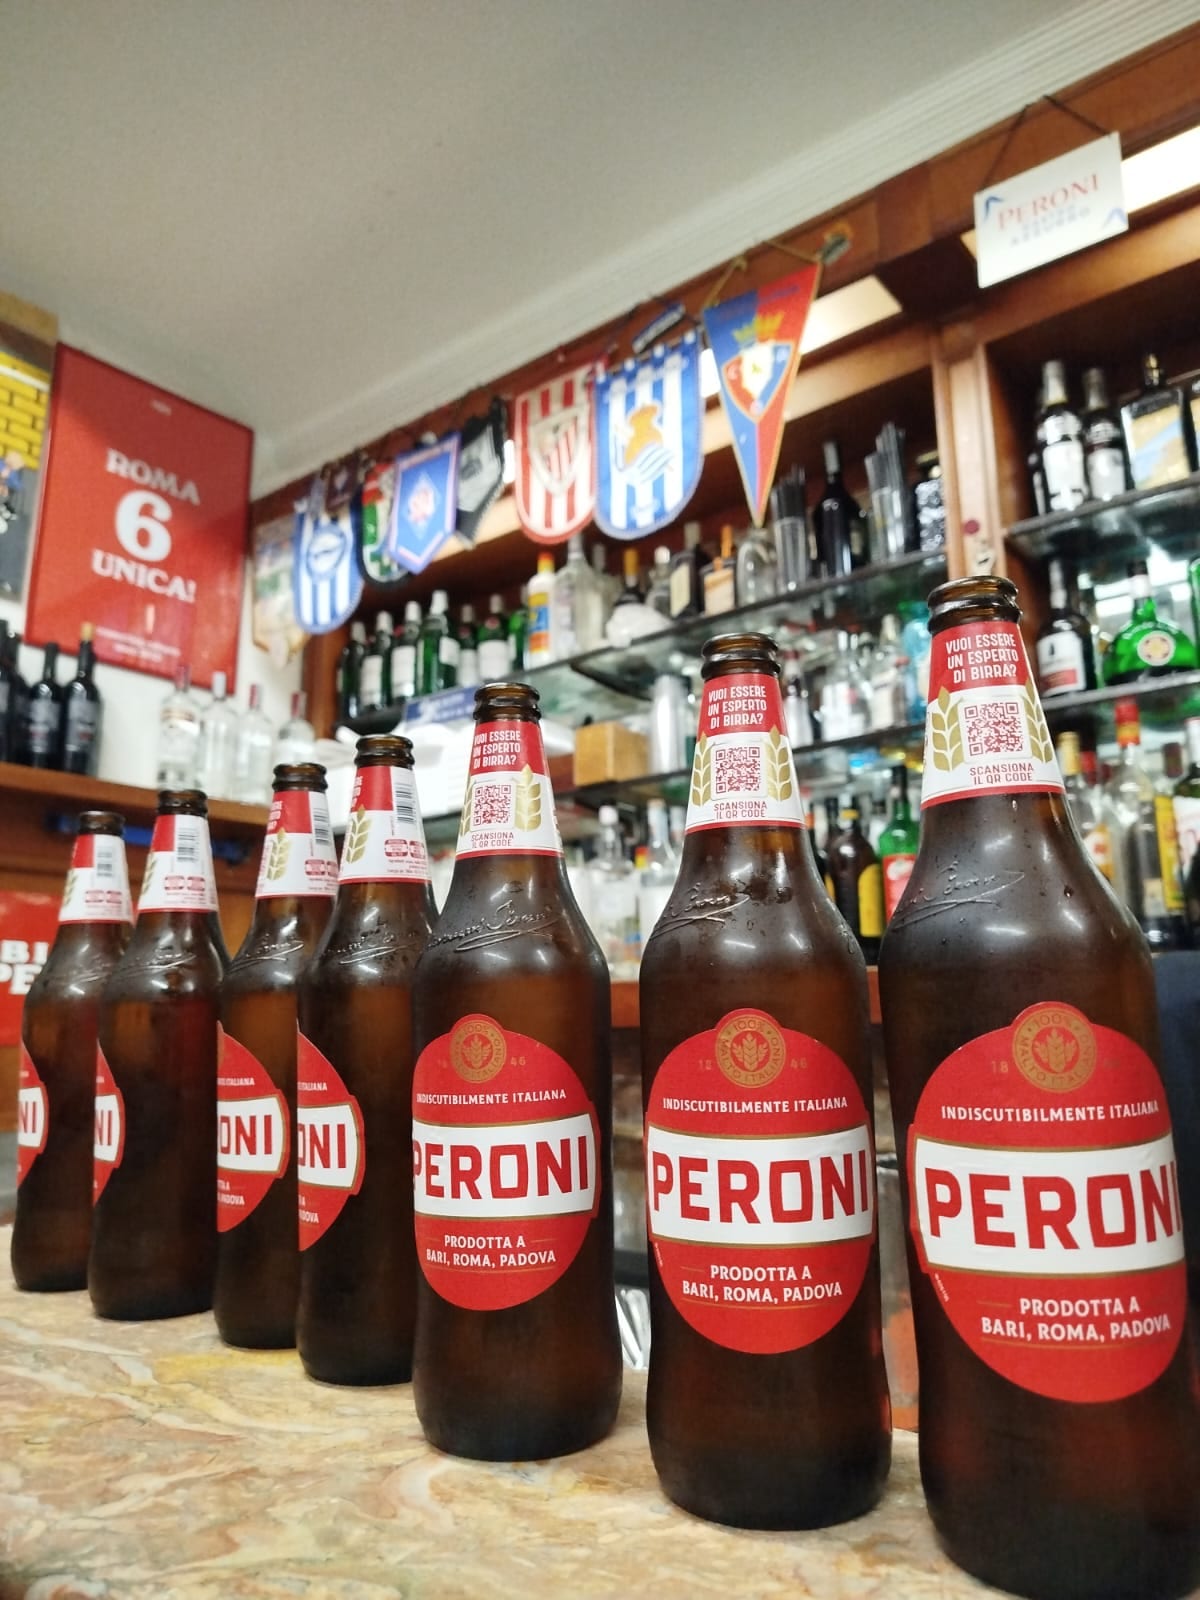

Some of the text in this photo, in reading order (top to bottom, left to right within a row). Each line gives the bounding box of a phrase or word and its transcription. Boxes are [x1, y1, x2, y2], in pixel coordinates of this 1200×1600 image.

[997, 173, 1099, 231] PERONI
[106, 448, 200, 505] ROMA
[115, 489, 173, 562] 6
[92, 549, 197, 603] UNICA!
[946, 633, 1017, 655] VUOI ESSERE
[947, 649, 1019, 669] UN ESPERTO
[953, 663, 1017, 684] DI BIRRA?
[708, 685, 766, 702] VUOI ESSERE
[708, 699, 767, 717] UN ESPERTO
[710, 712, 763, 730] DI BIRRA?
[489, 731, 521, 742] ESSERE
[482, 743, 521, 755] ESPERTO
[482, 755, 517, 767] BIRRA?
[969, 762, 1034, 777] SCANSIONA
[974, 771, 1033, 785] IL QR CODE
[713, 801, 767, 812] SCANSIONA
[716, 808, 766, 819] IL QR CODE
[471, 832, 514, 842] SCANSIONA
[513, 1089, 567, 1103] ITALIANA
[662, 1096, 848, 1113] INDISCUTIBILMENTE ITALIANA
[940, 1099, 1159, 1122] INDISCUTIBILMENTE ITALIANA
[412, 1135, 589, 1200] PERONI
[652, 1149, 869, 1225] PERONI
[444, 1234, 526, 1249] PRODOTTA A
[426, 1249, 556, 1269] BARI, ROMA, PADOVA
[710, 1264, 812, 1281] PRODOTTA A
[682, 1280, 842, 1304] BARI, ROMA, PADOVA
[1019, 1296, 1140, 1317] PRODOTTA A
[981, 1314, 1171, 1344] BARI, ROMA, PADOVA
